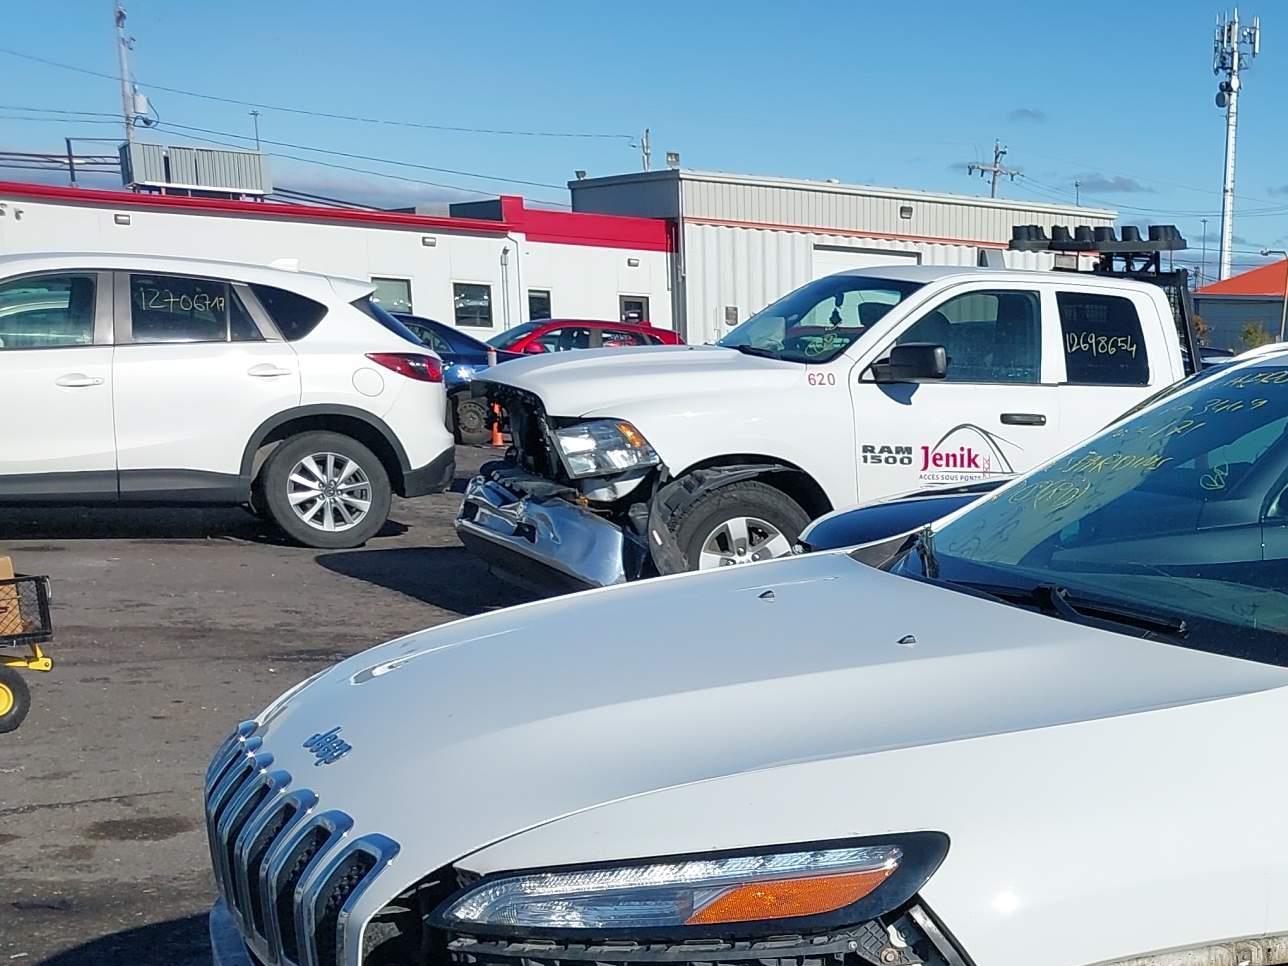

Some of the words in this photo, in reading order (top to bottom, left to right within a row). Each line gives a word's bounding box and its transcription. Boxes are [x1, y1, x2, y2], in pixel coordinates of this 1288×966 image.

[1065, 331, 1137, 360] 12698654
[807, 372, 836, 386] 620
[861, 444, 913, 455] RAM
[861, 455, 913, 465] 1500
[919, 445, 980, 471] Jenik
